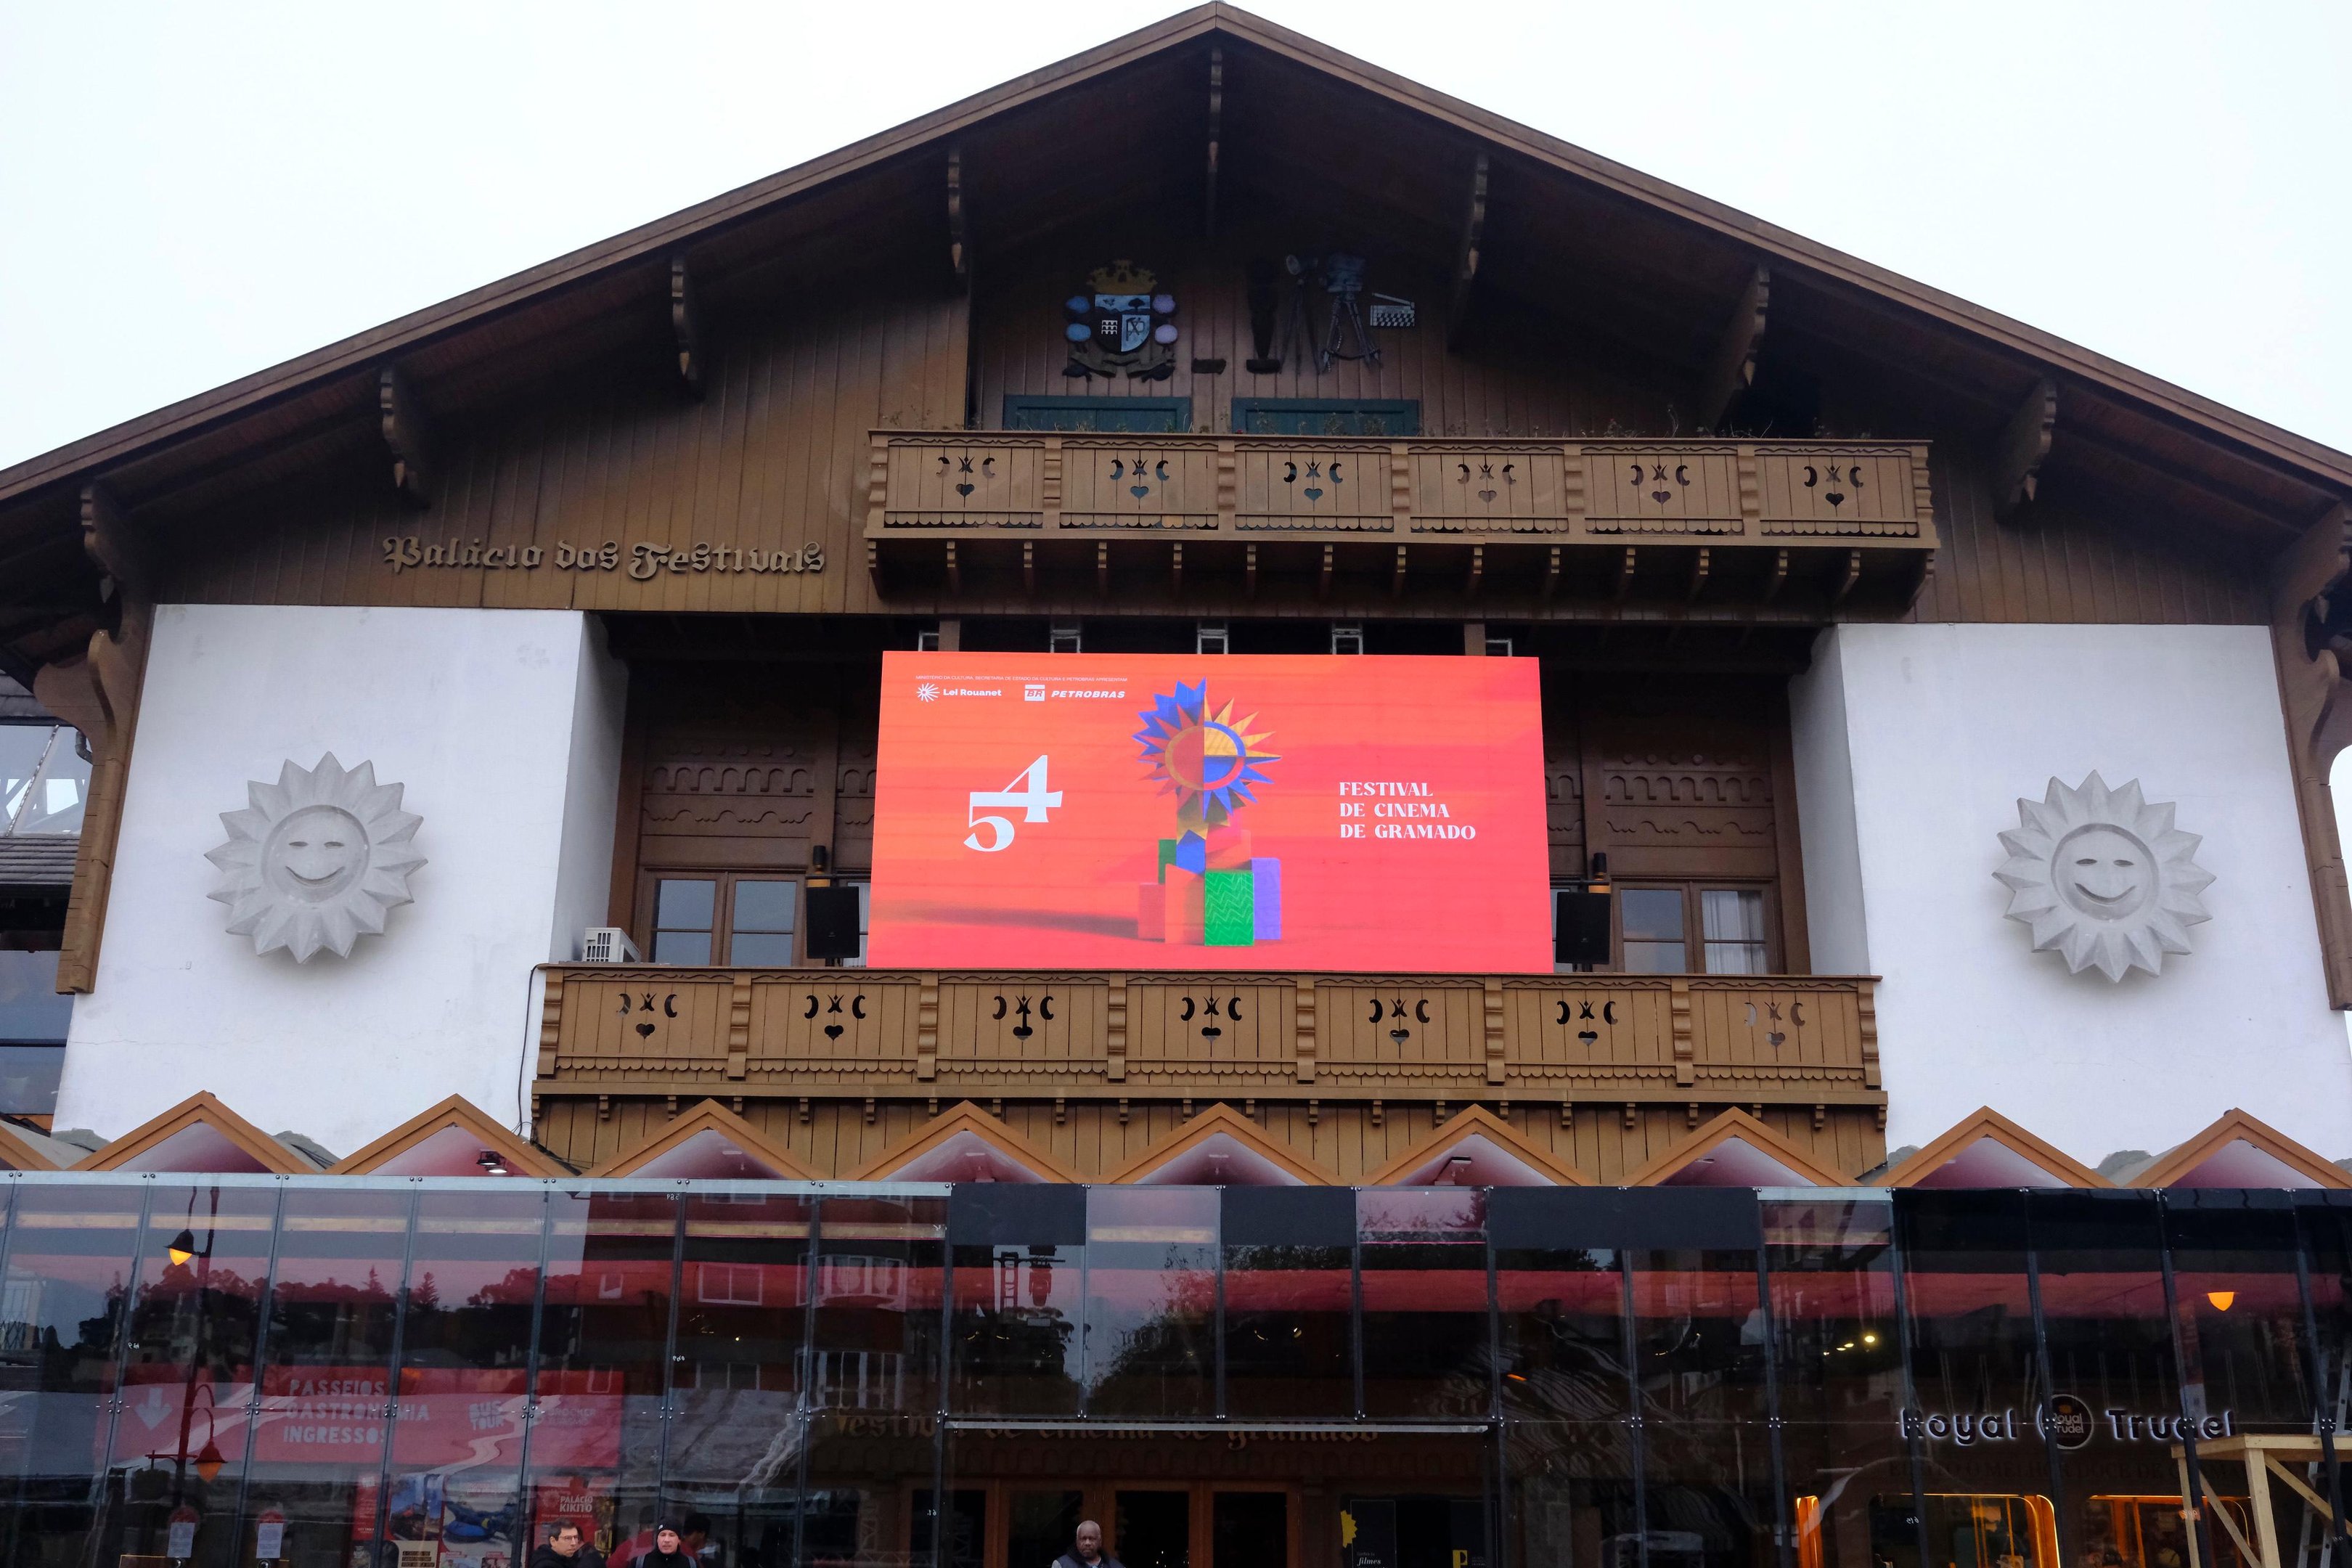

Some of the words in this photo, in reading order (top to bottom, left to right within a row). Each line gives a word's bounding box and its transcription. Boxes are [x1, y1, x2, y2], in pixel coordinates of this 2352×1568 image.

[383, 536, 544, 574] Palácio
[554, 539, 619, 571] dos
[628, 541, 825, 580] Festivais
[1026, 689, 1044, 698] BR
[1339, 782, 1434, 796] FESTIVAL
[1339, 803, 1365, 817] DE
[1373, 803, 1450, 818] CINEMA
[1339, 824, 1366, 838] DE
[1374, 824, 1476, 840] GRAMADO
[289, 1379, 385, 1397] PASSEIOS
[285, 1402, 430, 1421] GASTRONMIA
[2054, 1423, 2084, 1434] rudel
[560, 1494, 594, 1503] PALÁCIO
[559, 1503, 593, 1513] KIKITO
[1356, 1556, 1381, 1567] filmes
